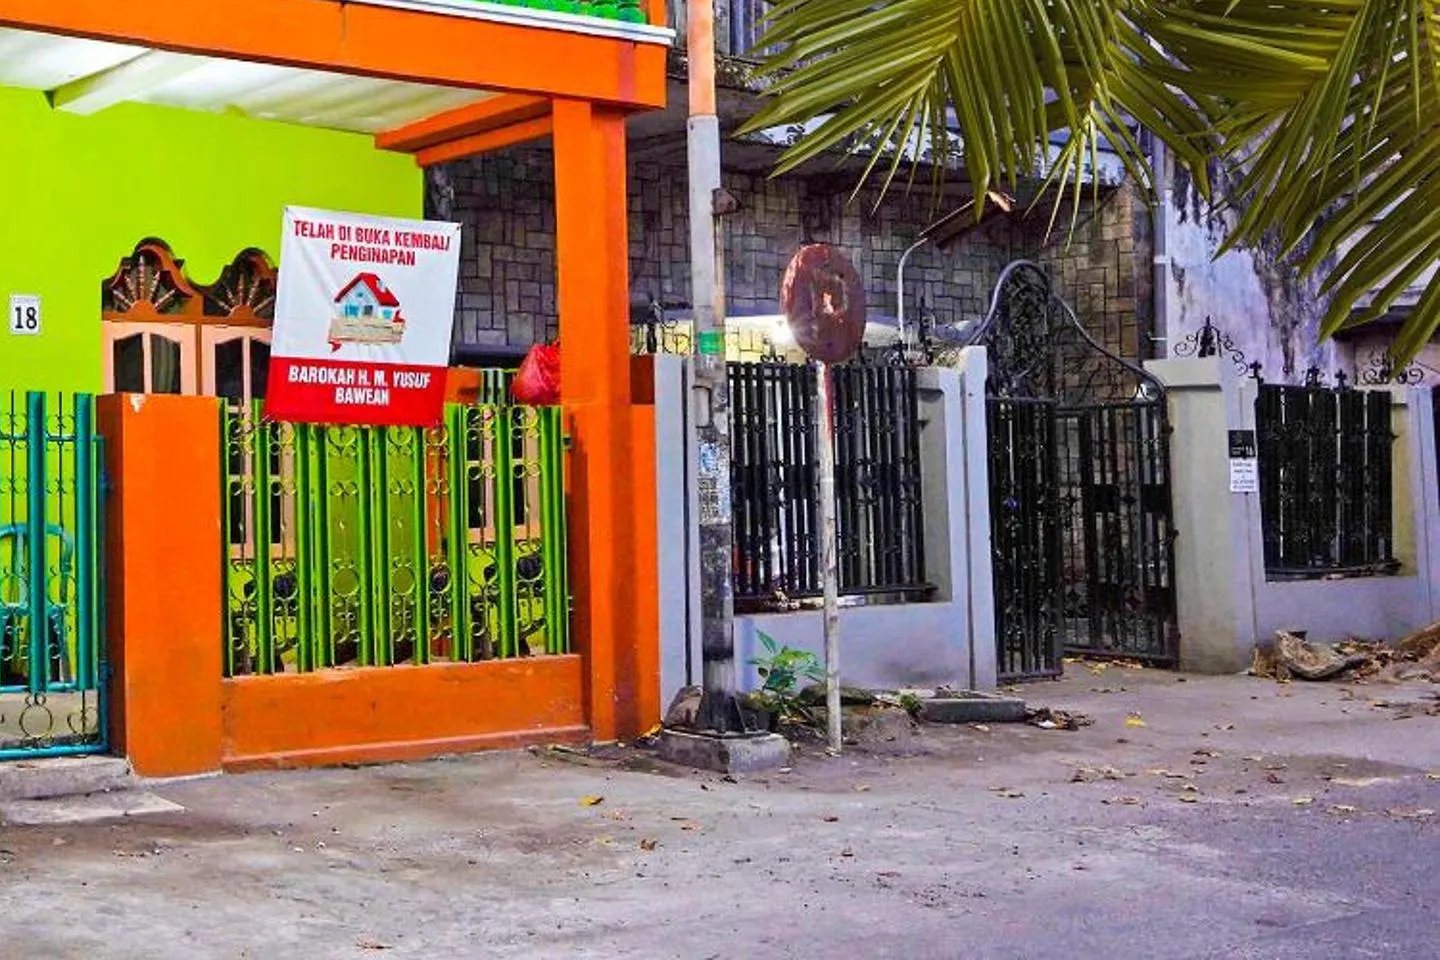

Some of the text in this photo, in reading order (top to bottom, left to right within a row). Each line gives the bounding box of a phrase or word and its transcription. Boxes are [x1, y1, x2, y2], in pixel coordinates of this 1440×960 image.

[293, 220, 450, 251] TELAH DI BUKA KEMBALI
[331, 243, 416, 266] PENGINAPAN
[14, 306, 37, 330] 18
[288, 365, 431, 389] BAROKAH H. M. YUSUF
[335, 387, 389, 406] BAWEAN
